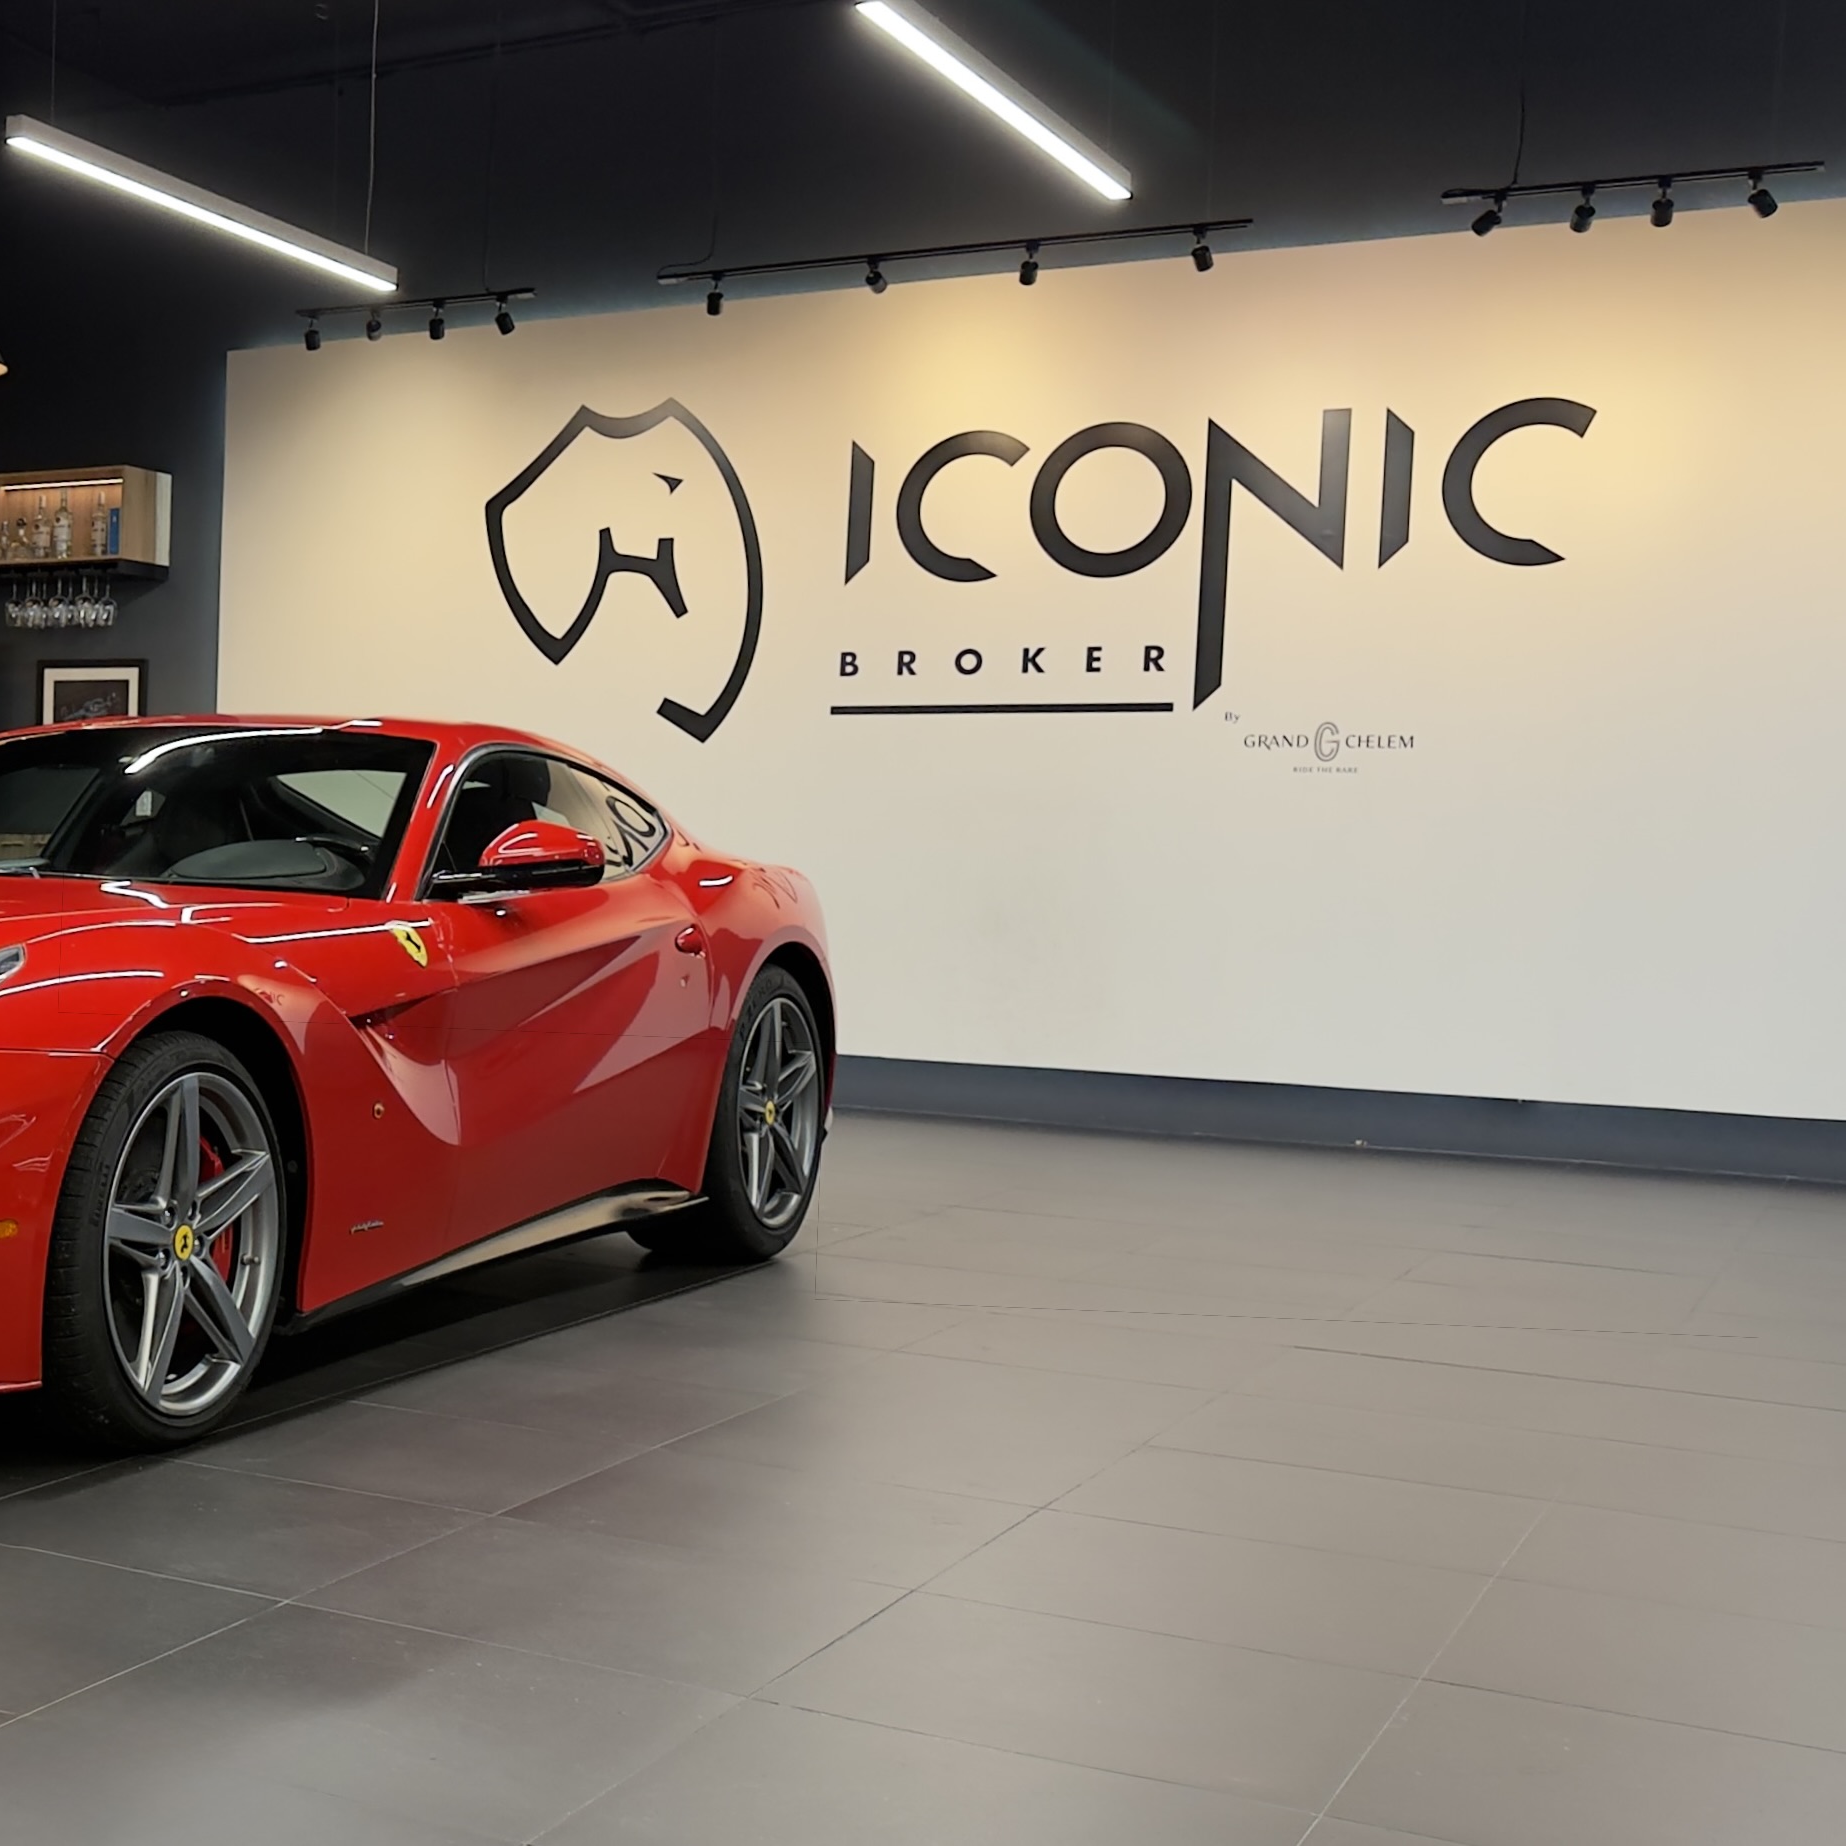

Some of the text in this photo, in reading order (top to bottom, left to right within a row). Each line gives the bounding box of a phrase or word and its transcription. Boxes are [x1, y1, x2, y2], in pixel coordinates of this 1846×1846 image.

[845, 398, 1596, 710] ICONIC
[840, 646, 1164, 676] BROKER
[1224, 711, 1241, 724] By
[1243, 733, 1310, 751] GRAND
[1344, 734, 1415, 750] CHELEM
